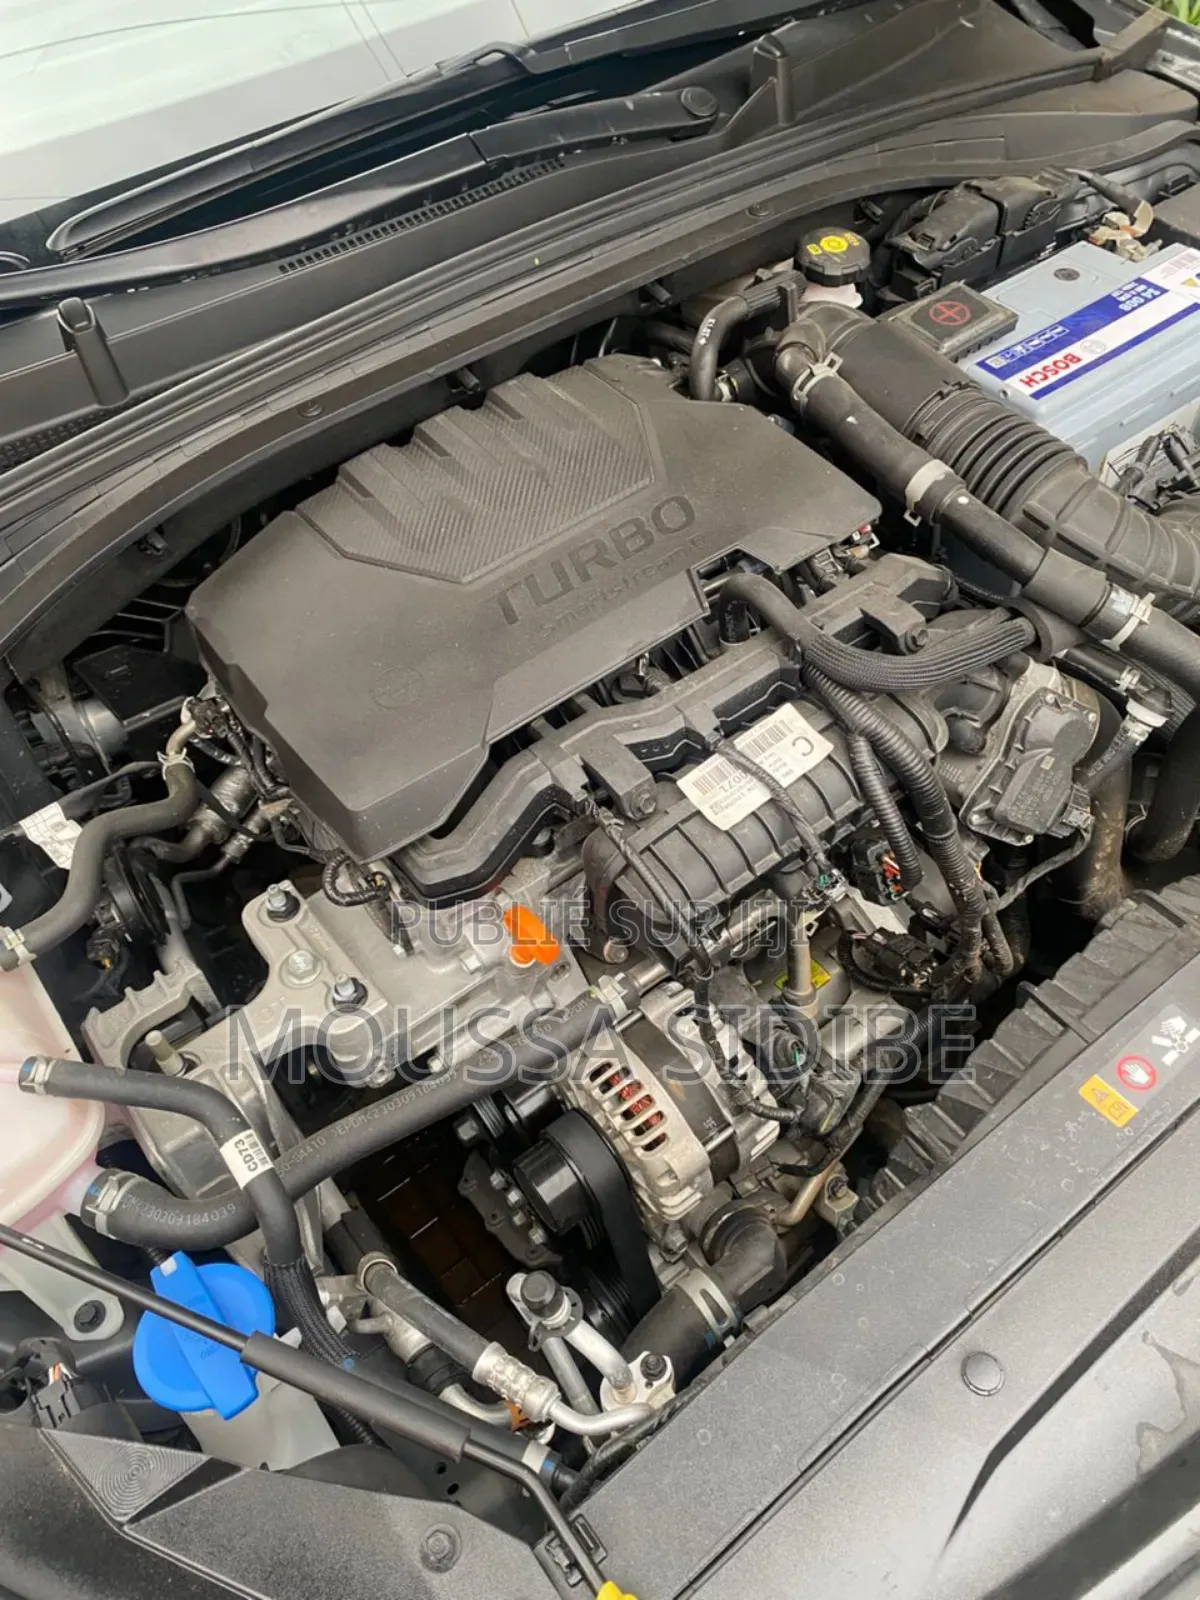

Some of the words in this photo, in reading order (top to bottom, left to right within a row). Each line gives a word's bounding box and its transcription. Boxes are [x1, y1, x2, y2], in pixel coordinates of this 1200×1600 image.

[1020, 353, 1083, 388] BOSCH
[487, 495, 696, 626] TURBO
[792, 735, 815, 757] C
[234, 1138, 259, 1172] CD73
